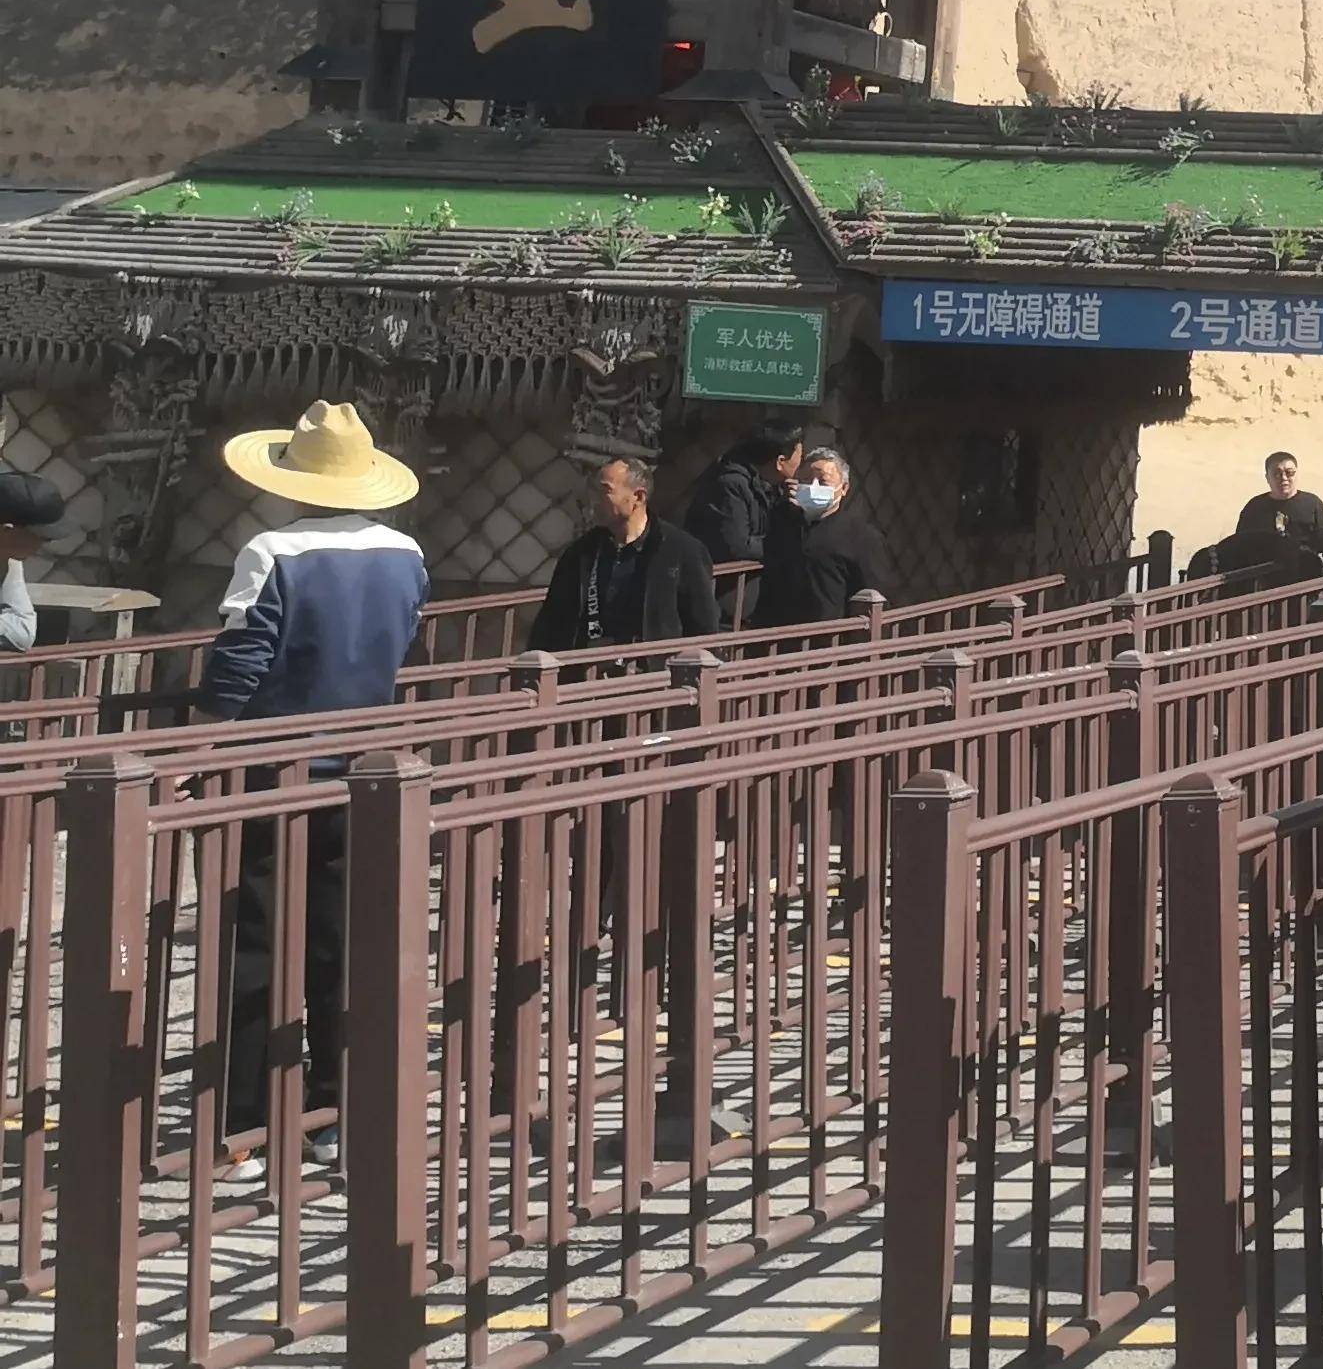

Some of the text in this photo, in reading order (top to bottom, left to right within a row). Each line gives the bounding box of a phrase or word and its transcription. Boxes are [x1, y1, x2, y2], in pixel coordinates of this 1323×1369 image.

[913, 289, 1103, 342] 1号无障碍通道
[1169, 298, 1323, 350] 2号通道
[715, 327, 795, 352] 军人优先
[703, 356, 804, 377] 消防救援人员优先
